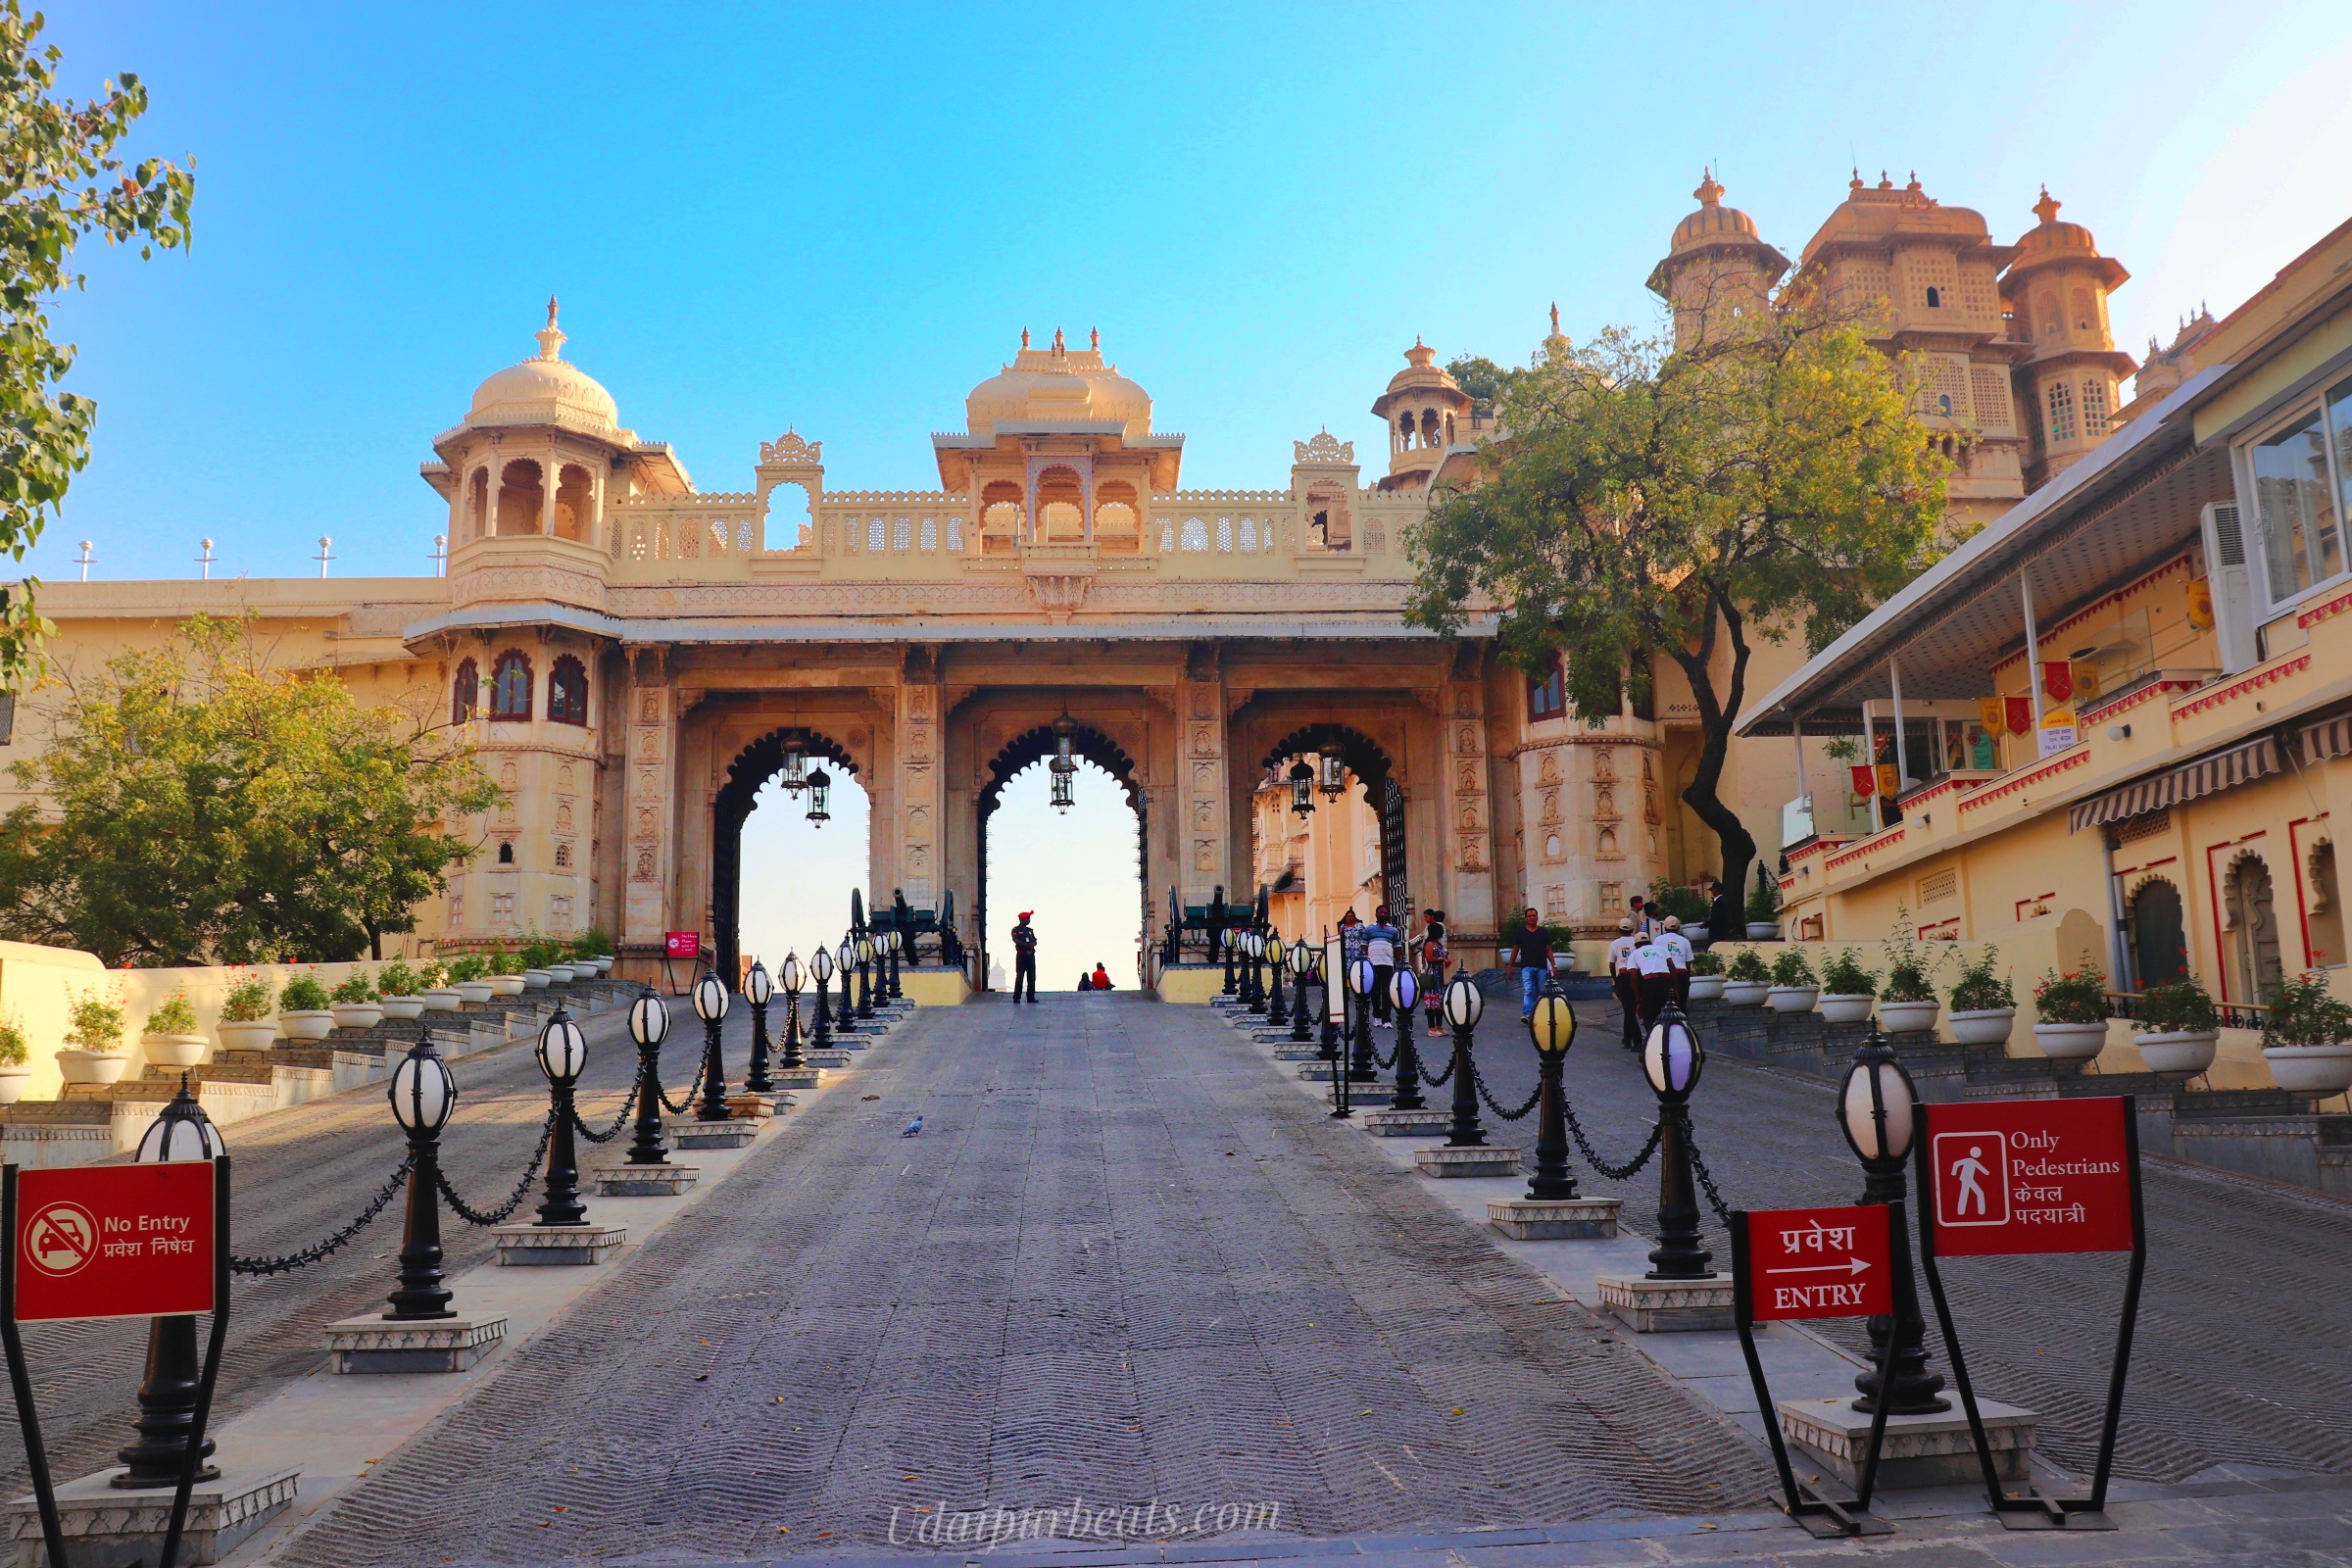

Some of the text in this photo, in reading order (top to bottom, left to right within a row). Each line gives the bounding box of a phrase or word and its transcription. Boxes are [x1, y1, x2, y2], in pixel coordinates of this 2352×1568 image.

[2011, 1130, 2060, 1153] Only
[2012, 1157, 2120, 1176] Pedestrians
[2013, 1182, 2063, 1202] केवल
[2014, 1202, 2085, 1224] पदयात्री
[104, 1215, 190, 1234] No Entry
[103, 1236, 195, 1257] प्रवेश निषेध
[1779, 1218, 1856, 1254] प्रवेश
[1774, 1283, 1867, 1309] ENTRY
